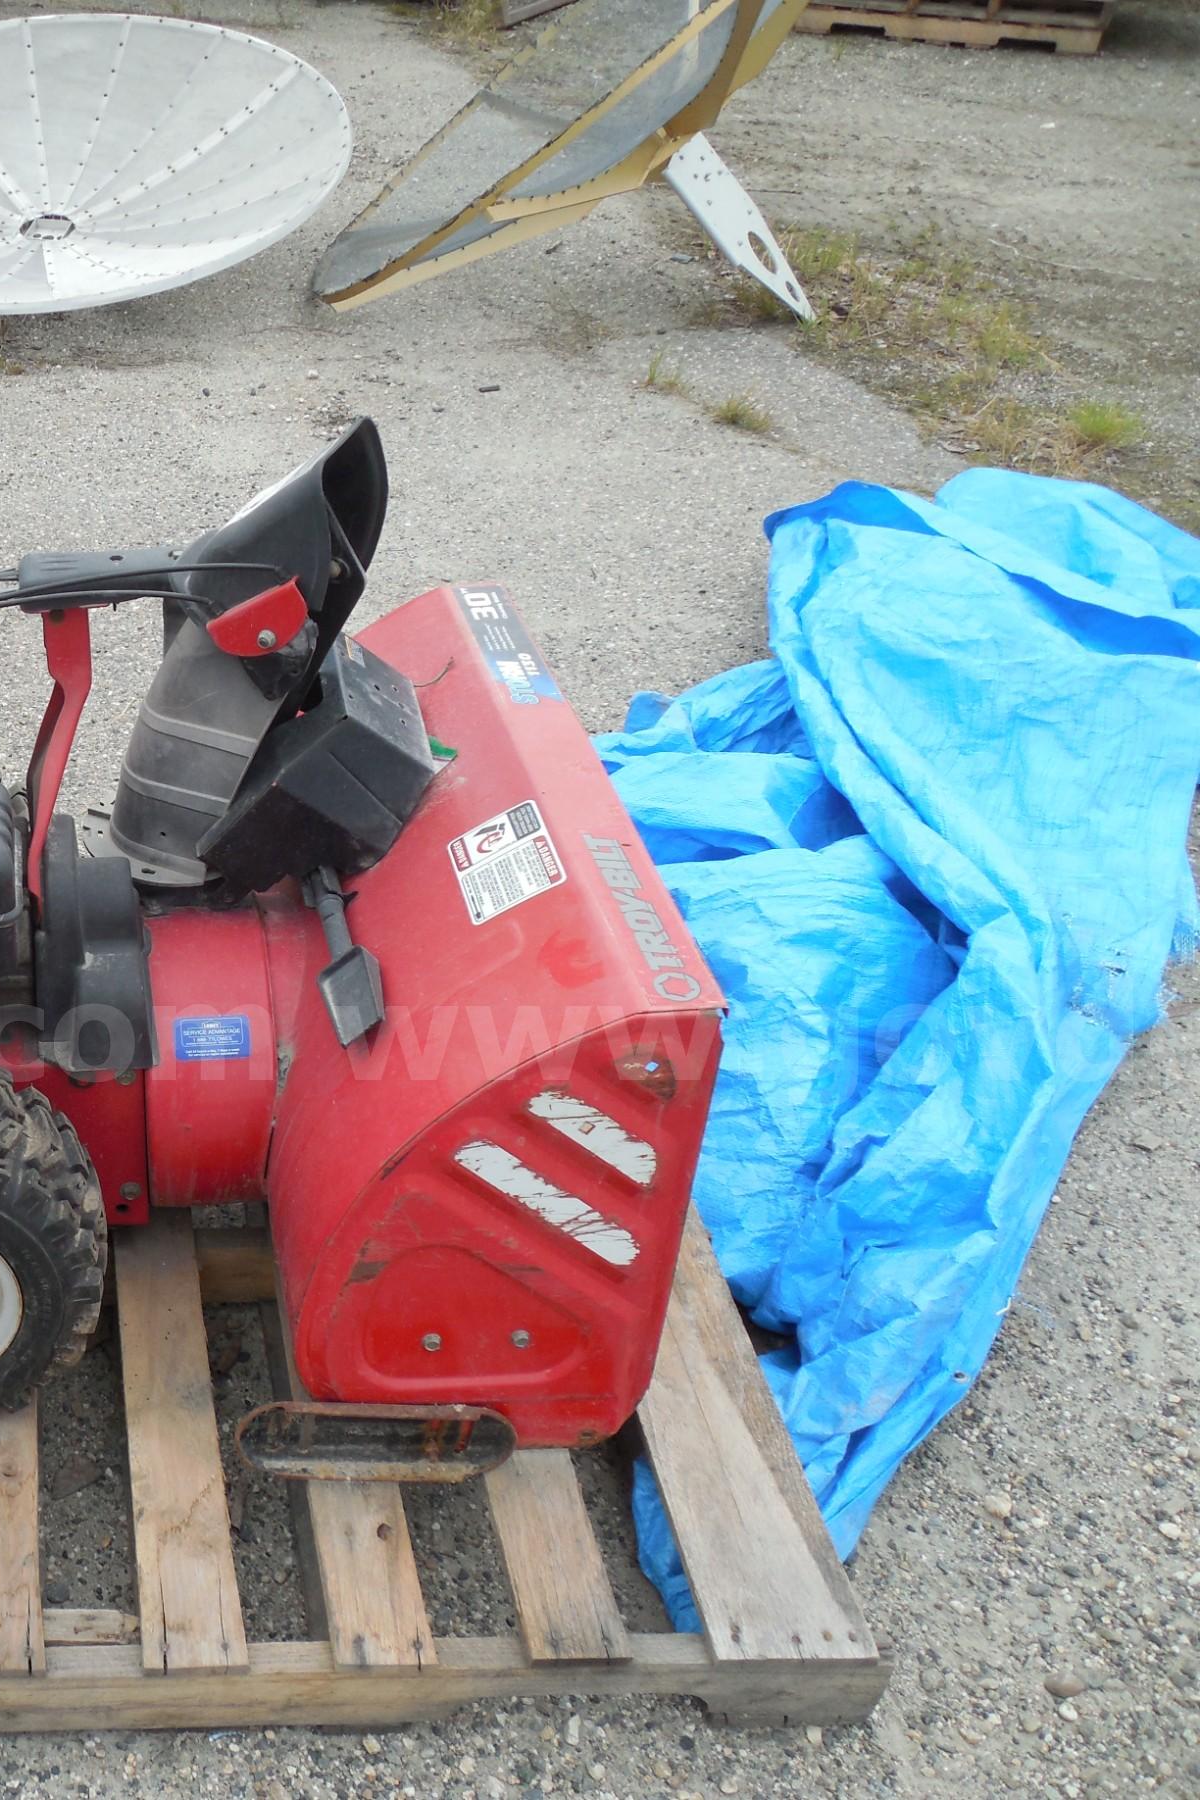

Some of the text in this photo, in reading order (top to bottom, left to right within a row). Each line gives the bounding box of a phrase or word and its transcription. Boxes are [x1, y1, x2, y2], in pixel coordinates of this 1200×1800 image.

[495, 660, 540, 704] STORM
[538, 847, 559, 877] DANGER
[582, 833, 685, 971] TROY-BILT
